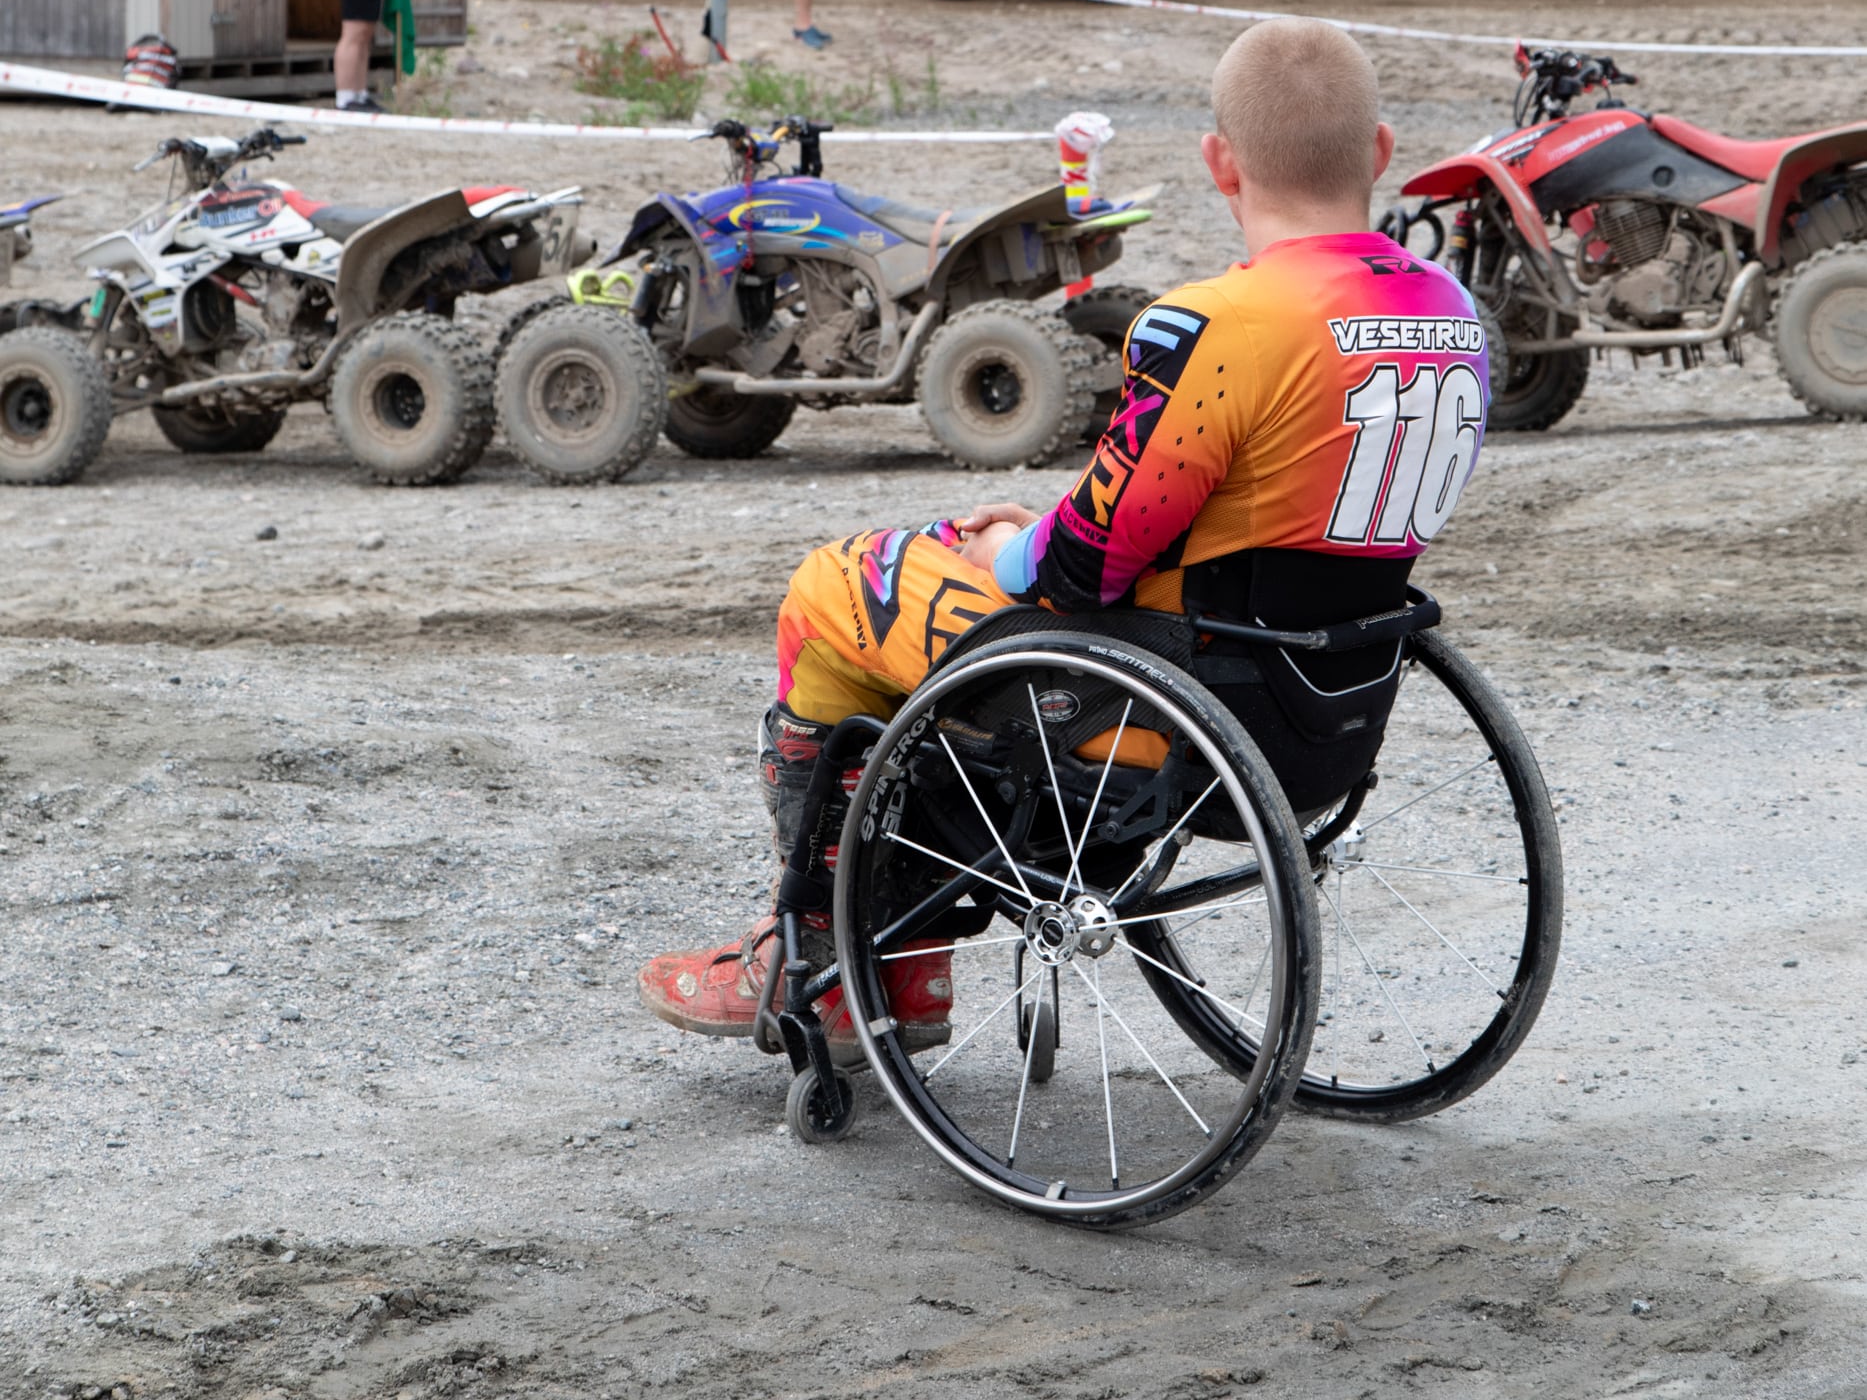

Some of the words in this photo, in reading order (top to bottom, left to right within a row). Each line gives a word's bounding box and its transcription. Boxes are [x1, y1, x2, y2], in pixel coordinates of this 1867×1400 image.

[1328, 317, 1485, 354] VESETRUD
[1324, 363, 1484, 544] 116
[1107, 649, 1168, 684] SENTINEL
